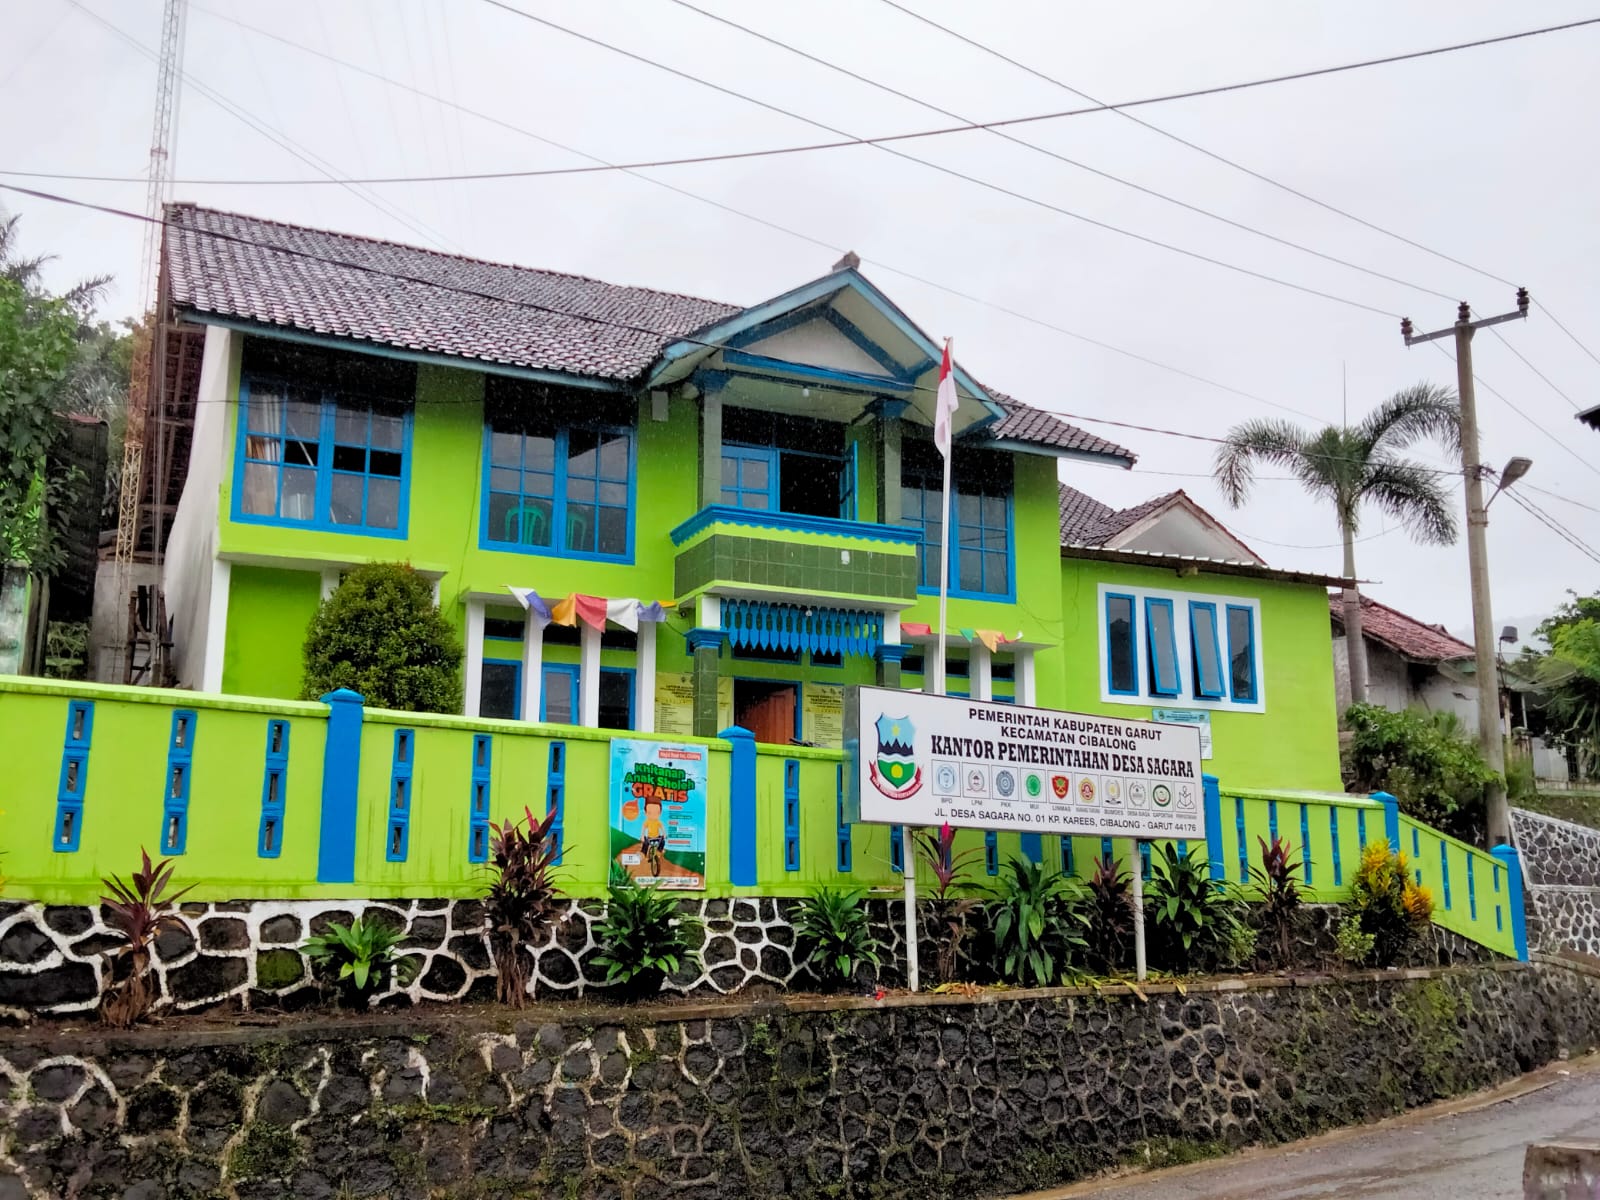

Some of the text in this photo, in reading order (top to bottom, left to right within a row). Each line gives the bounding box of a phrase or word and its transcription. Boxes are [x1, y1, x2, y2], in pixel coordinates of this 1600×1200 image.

[969, 708, 1162, 741] PEMERINTAH KABUPATEN GARUT
[1001, 726, 1137, 751] KECAMATAN CIBALONG
[931, 735, 1194, 778] KANTOR PEMERINTAHAN DESA SAGARA
[624, 772, 696, 791] Anak Sholeh
[634, 763, 686, 779] Khitanan
[631, 782, 688, 803] GRATIS
[935, 808, 948, 817] JL.
[951, 808, 976, 819] DESA
[978, 810, 1016, 821] SAGARA
[1017, 813, 1033, 823] NO.
[1035, 814, 1045, 823] 01
[1048, 815, 1061, 824] KP.
[1063, 816, 1098, 828] KAREES,
[1099, 818, 1140, 829] CIBALONG
[1147, 820, 1173, 831] GARUT
[1174, 823, 1197, 832] 44176
